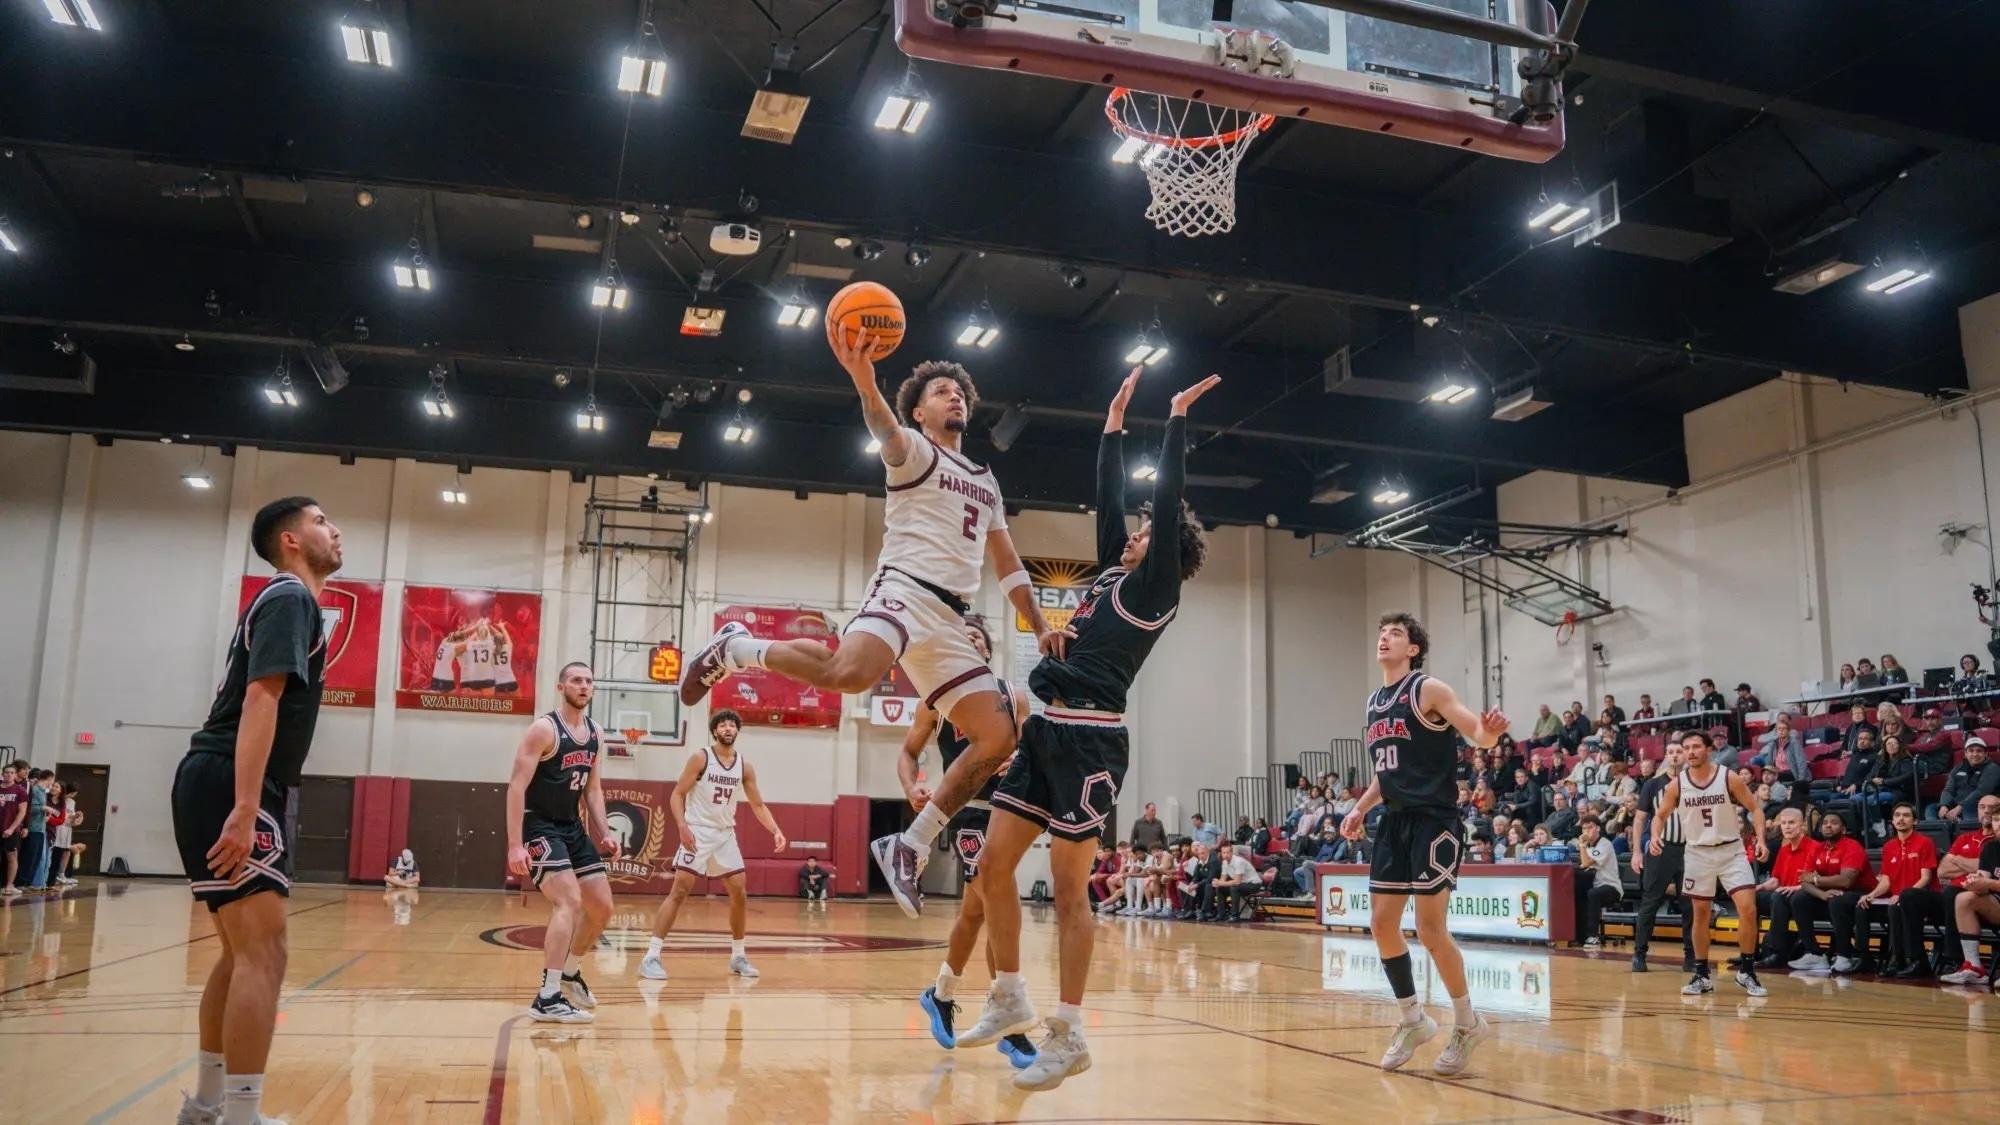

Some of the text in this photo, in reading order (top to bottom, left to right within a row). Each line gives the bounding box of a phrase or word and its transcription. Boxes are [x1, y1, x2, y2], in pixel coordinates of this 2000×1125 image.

[861, 314, 904, 330] Wilson
[939, 473, 996, 509] WARRIOR
[962, 502, 979, 542] 2
[473, 649, 489, 663] 13
[652, 657, 678, 680] 22
[420, 695, 512, 711] WARRIORS
[1375, 744, 1399, 772] 20
[570, 770, 588, 791] 24
[601, 789, 653, 803] STMONT
[712, 787, 733, 805] 24
[1684, 794, 1726, 808] WARRIORS
[1701, 808, 1713, 827] 5
[256, 831, 274, 852] U
[605, 862, 648, 876] RRIORS
[1447, 897, 1510, 917] ARRIORS
